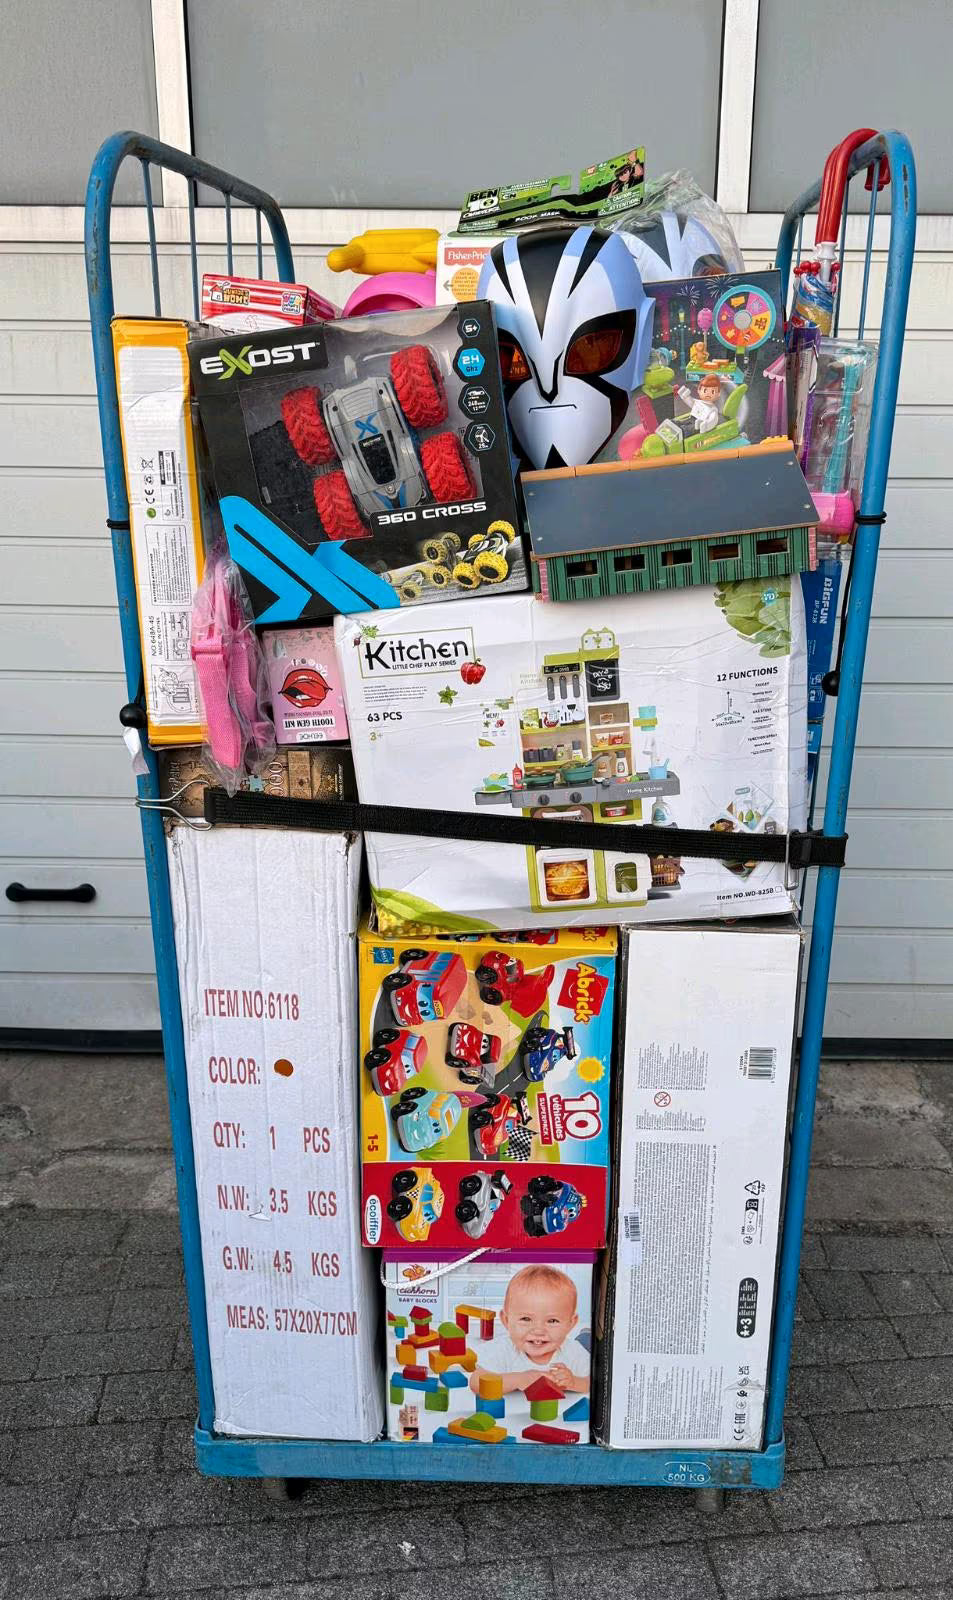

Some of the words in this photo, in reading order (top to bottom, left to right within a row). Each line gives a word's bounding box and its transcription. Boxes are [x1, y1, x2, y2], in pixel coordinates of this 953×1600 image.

[468, 190, 498, 202] BEN
[467, 197, 500, 213] 10
[447, 250, 488, 261] Fisher-Pric
[464, 324, 478, 334] 5+
[377, 511, 417, 526] 360
[422, 501, 487, 520] CROSS
[364, 638, 469, 671] Kitchen
[392, 663, 409, 671] LITTLE
[409, 662, 423, 670] CHEF
[439, 659, 457, 667] SERIES
[717, 673, 727, 682] 12
[728, 666, 779, 681] FUNCTIONS
[284, 720, 296, 729] KIT
[297, 719, 311, 728] GEM
[312, 717, 334, 727] TOOTH
[367, 713, 380, 722] 63
[382, 711, 403, 721] PCS
[574, 962, 597, 1022] Abrick
[204, 988, 240, 1018] ITEM
[208, 1056, 261, 1085] COLOR:
[562, 1092, 600, 1139] 10
[213, 1121, 246, 1149] QTY:
[269, 1125, 276, 1150] 1
[303, 1126, 331, 1153] PCS
[367, 1133, 379, 1152] 1-5
[217, 1184, 250, 1211] N.W:
[269, 1187, 289, 1213] 3.5
[307, 1190, 337, 1216] KGS
[222, 1246, 254, 1271] G.W:
[273, 1250, 293, 1274] 4.5
[311, 1252, 340, 1277] KGS
[226, 1304, 270, 1331] MEAS:
[274, 1308, 358, 1336] 57X20X77CM
[679, 1464, 693, 1473] NL
[667, 1473, 686, 1481] 500
[689, 1473, 705, 1482] KG
